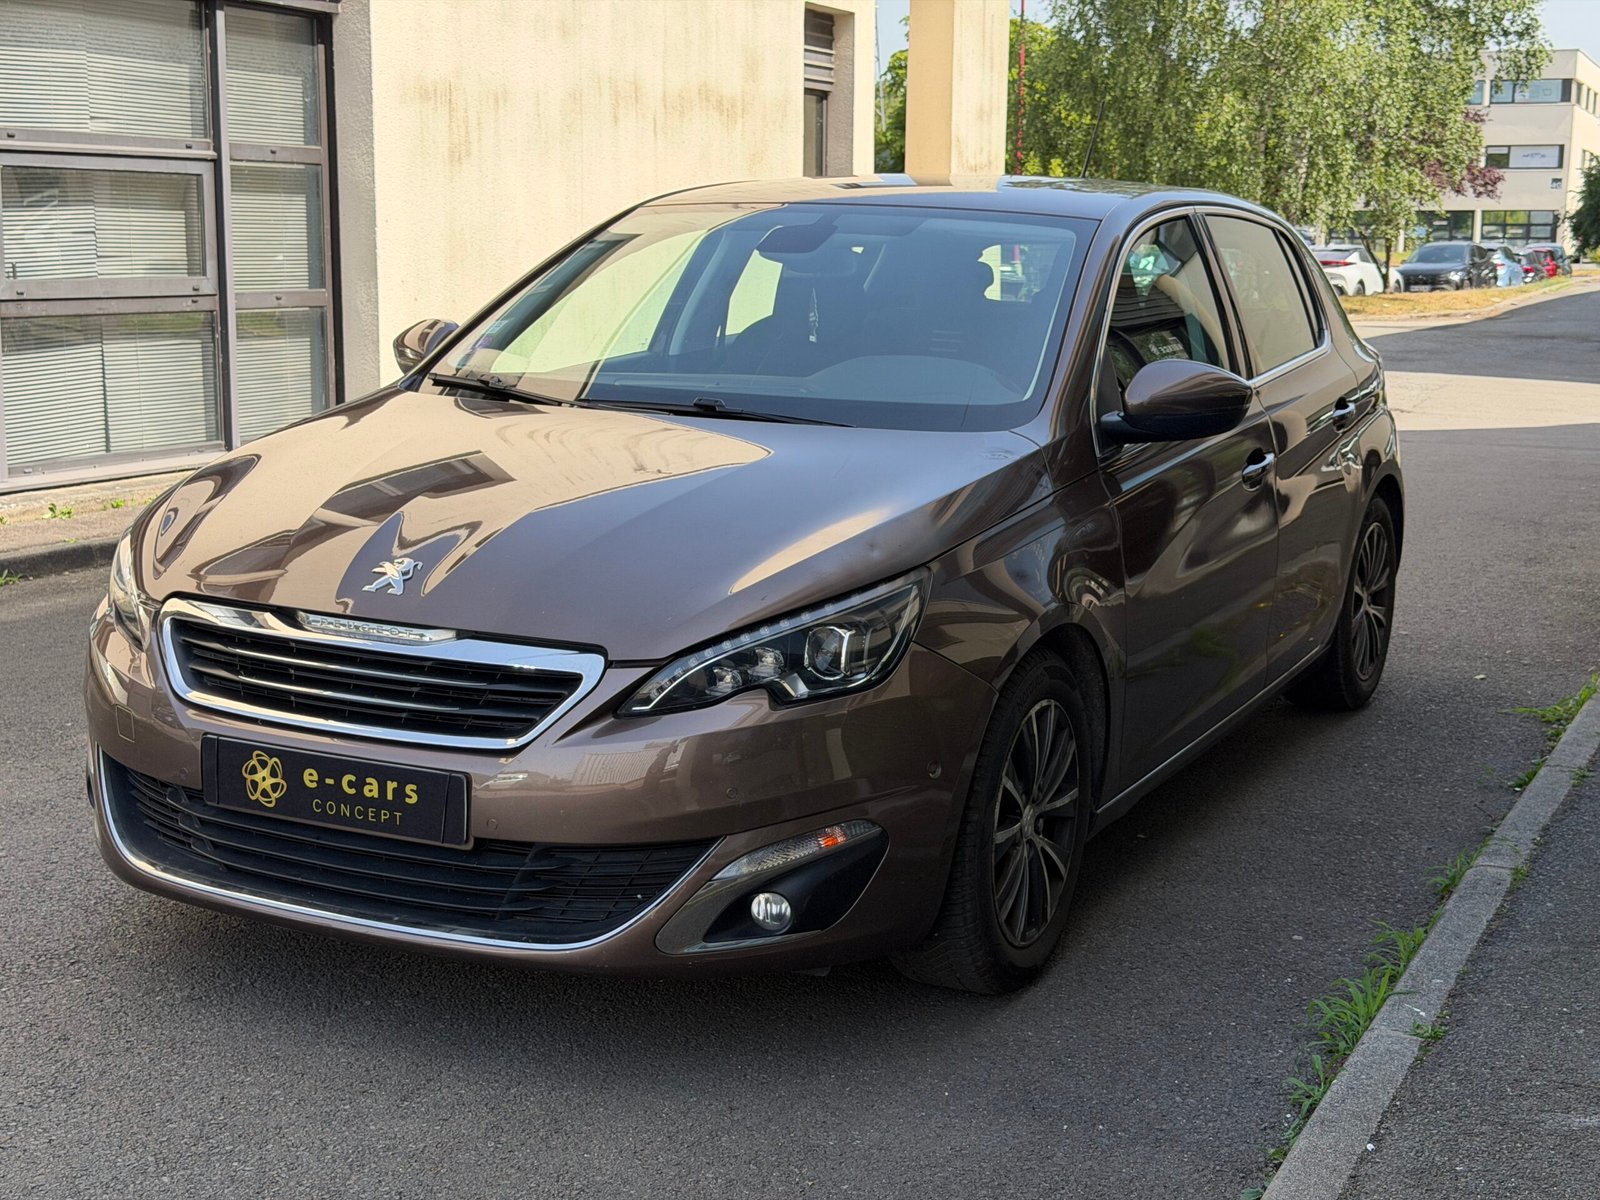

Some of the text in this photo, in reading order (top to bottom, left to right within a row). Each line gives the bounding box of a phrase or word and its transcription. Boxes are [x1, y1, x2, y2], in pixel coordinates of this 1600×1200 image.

[320, 617, 413, 638] PEUGEOT
[302, 767, 418, 804] e-cars
[312, 799, 402, 825] CONCEPT
